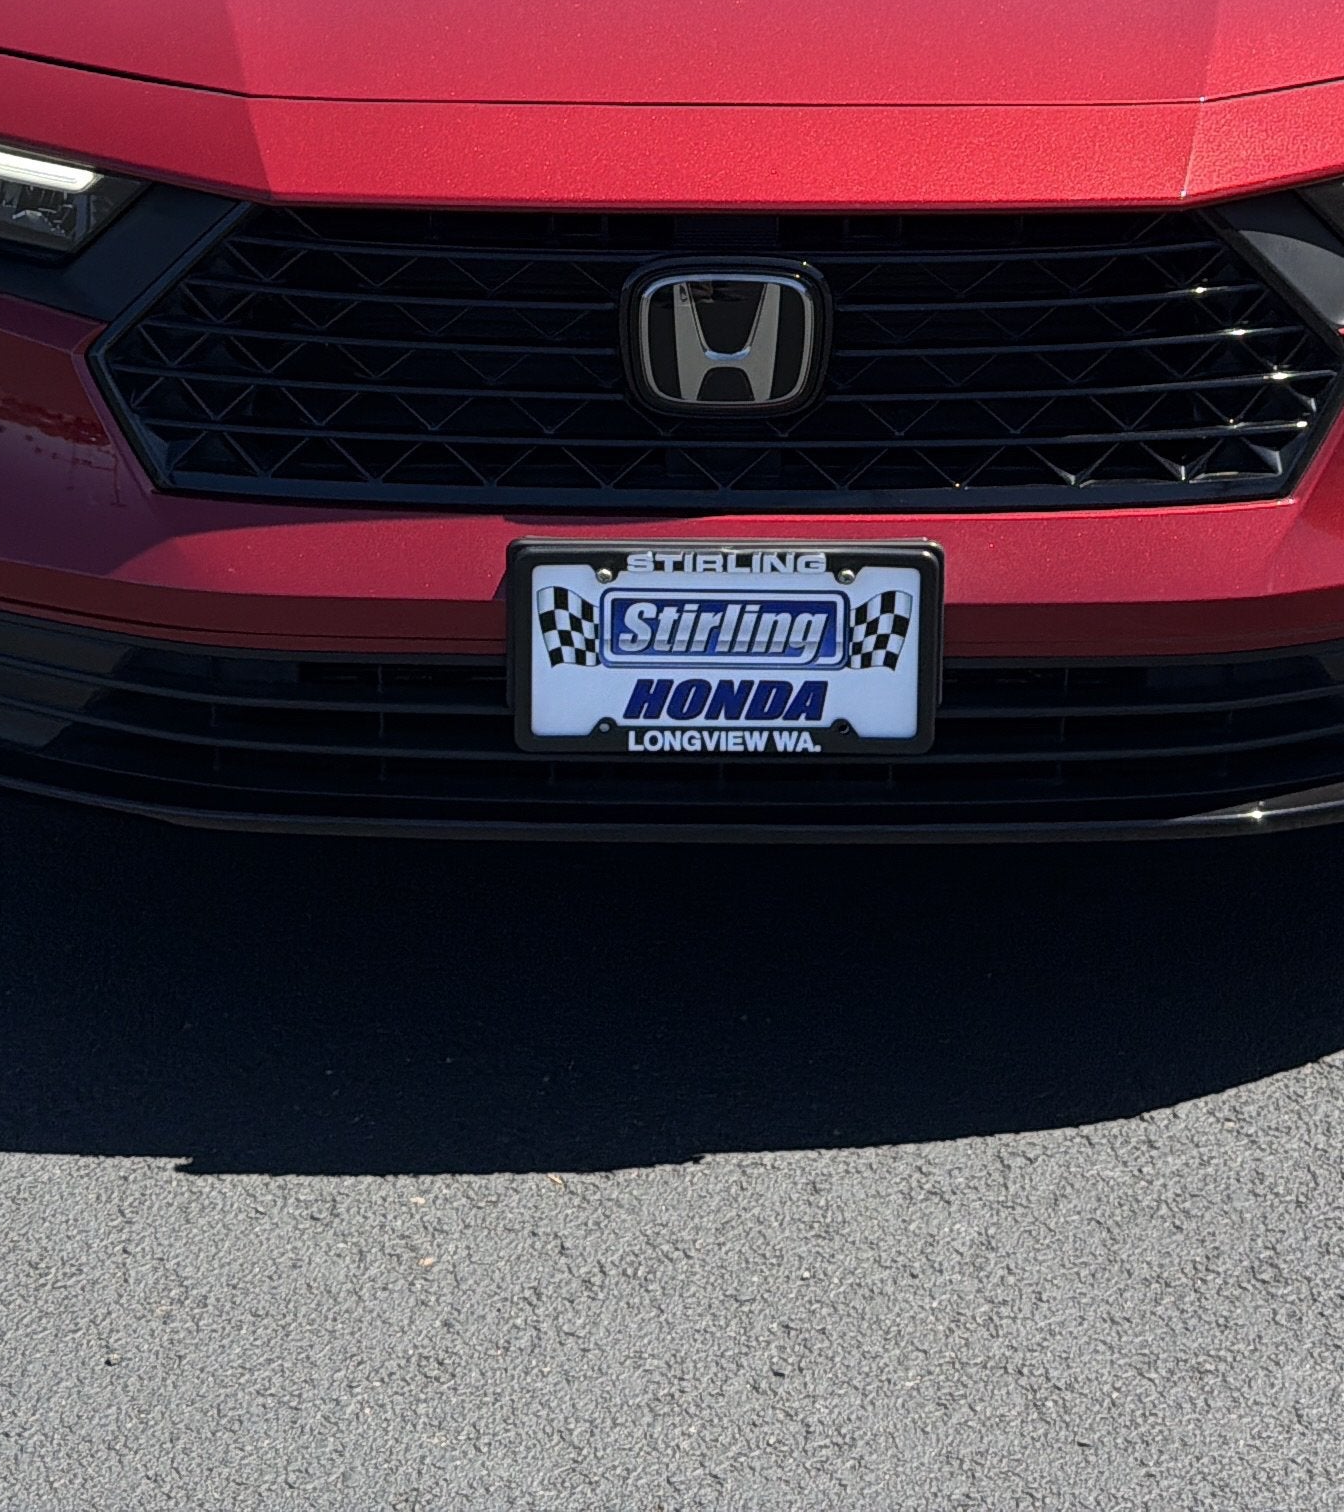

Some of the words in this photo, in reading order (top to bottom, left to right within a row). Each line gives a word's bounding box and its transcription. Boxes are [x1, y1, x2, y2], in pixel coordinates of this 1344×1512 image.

[626, 551, 828, 575] STIRLING
[617, 601, 830, 665] Stirling
[622, 678, 829, 722] HONDA
[628, 730, 772, 753] LONGVIEW
[773, 731, 822, 753] WA.
